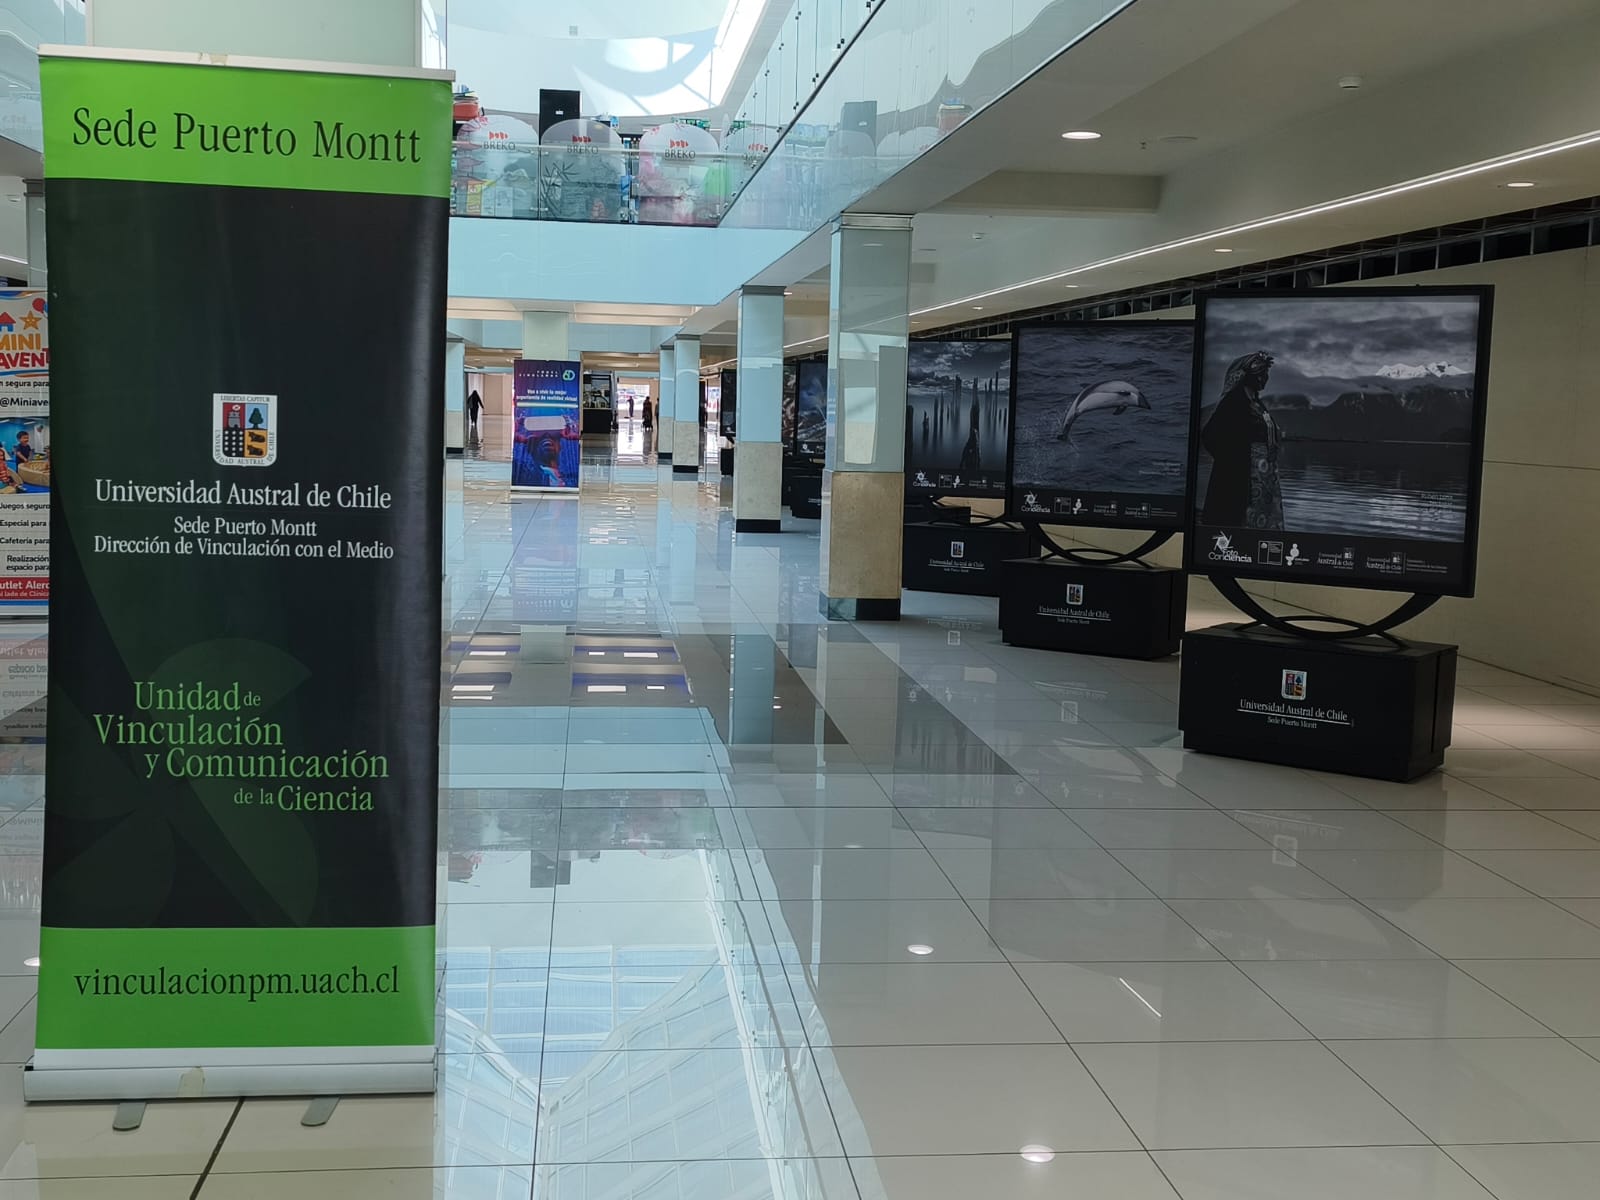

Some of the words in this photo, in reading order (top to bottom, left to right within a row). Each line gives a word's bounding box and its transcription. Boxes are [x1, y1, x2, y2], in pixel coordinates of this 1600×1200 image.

[73, 107, 157, 148] Sede
[173, 112, 297, 156] Puerto
[312, 120, 421, 163] Montt
[483, 140, 516, 151] BREKO
[567, 144, 599, 154] BREKO
[664, 149, 696, 159] BREKO
[0, 333, 41, 351] MINI
[95, 479, 222, 504] Universidad
[226, 482, 301, 507] Austral
[306, 483, 331, 507] de
[337, 485, 392, 509] Chile
[0, 519, 29, 528] Especial
[30, 520, 47, 528] para
[174, 516, 210, 535] Sede
[215, 517, 266, 536] Puerto
[271, 519, 317, 537] Montt
[94, 535, 170, 555] Dirección
[174, 536, 193, 555] de
[197, 538, 291, 557] Vinculación
[295, 543, 324, 558] con
[328, 539, 342, 558] el
[346, 540, 394, 560] Medio
[6, 563, 33, 572] espacio
[134, 681, 241, 711] Unidad
[243, 690, 261, 707] de
[1240, 698, 1285, 714] Universidad
[1286, 704, 1314, 717] Austral
[1315, 707, 1325, 718] de
[1326, 709, 1348, 721] Chile
[93, 713, 284, 745] Vinculación
[143, 753, 161, 779] y
[166, 747, 390, 778] Comunicación
[233, 787, 254, 805] de
[259, 787, 274, 805] la
[277, 784, 375, 811] Ciencia
[73, 964, 401, 1003] vinculacionpm.uach.cl
